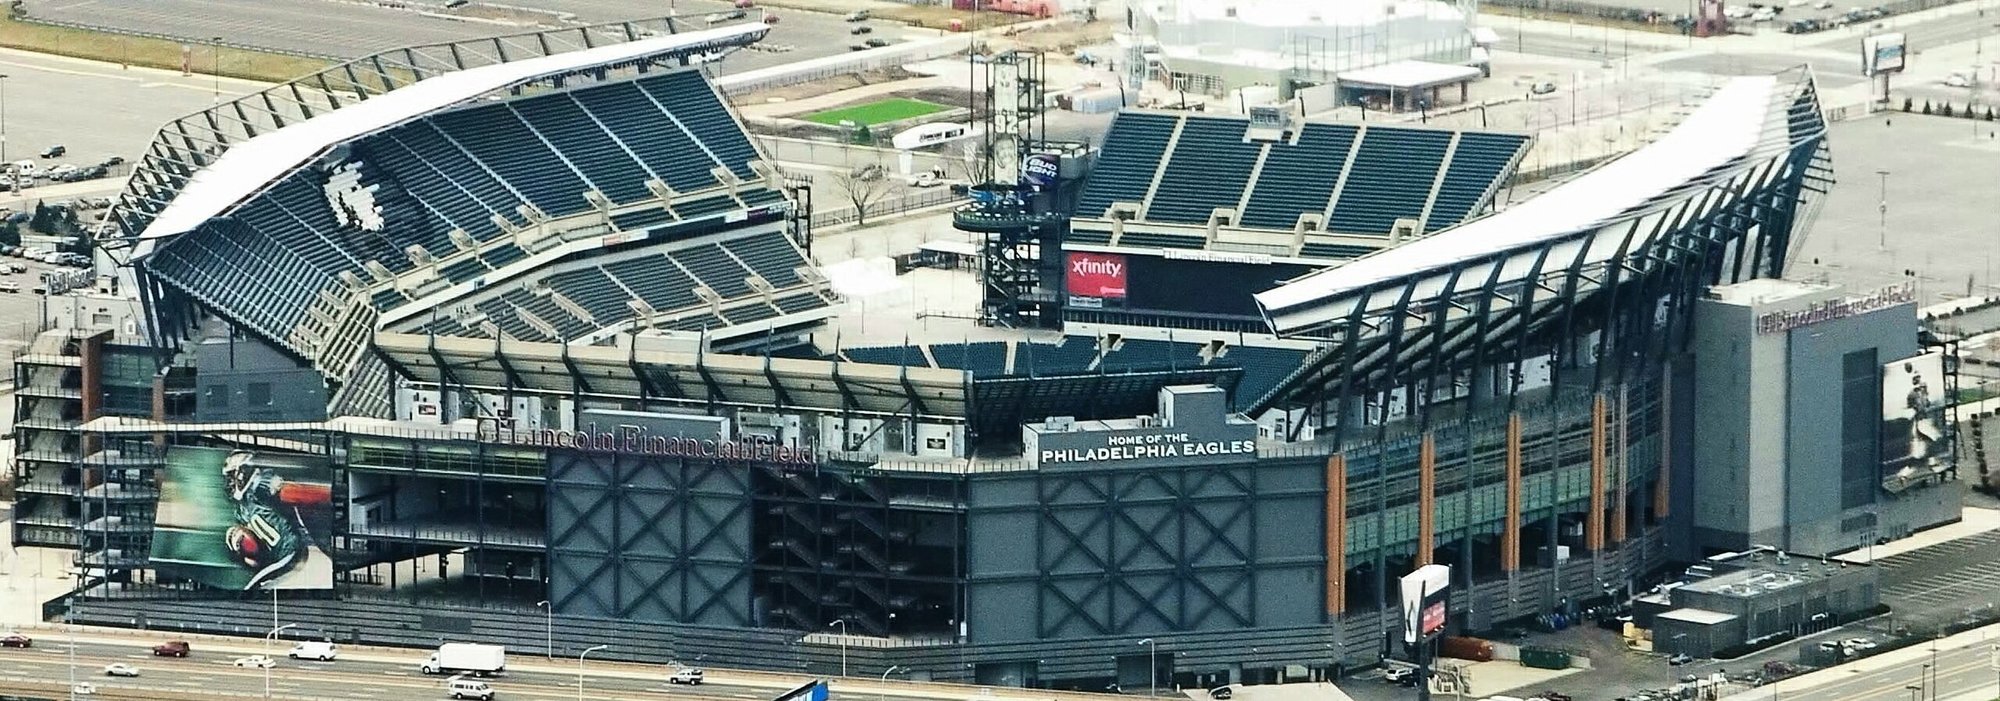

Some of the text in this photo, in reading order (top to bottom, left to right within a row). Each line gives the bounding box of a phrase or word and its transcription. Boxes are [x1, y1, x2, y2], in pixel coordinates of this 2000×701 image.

[1029, 158, 1057, 170] BUD
[1073, 258, 1121, 277] xfinity
[508, 417, 816, 464] Lincoln Financial Field
[1108, 433, 1189, 446] HOME OF THE
[1042, 441, 1255, 463] PHILADELPHIA EAGLES
